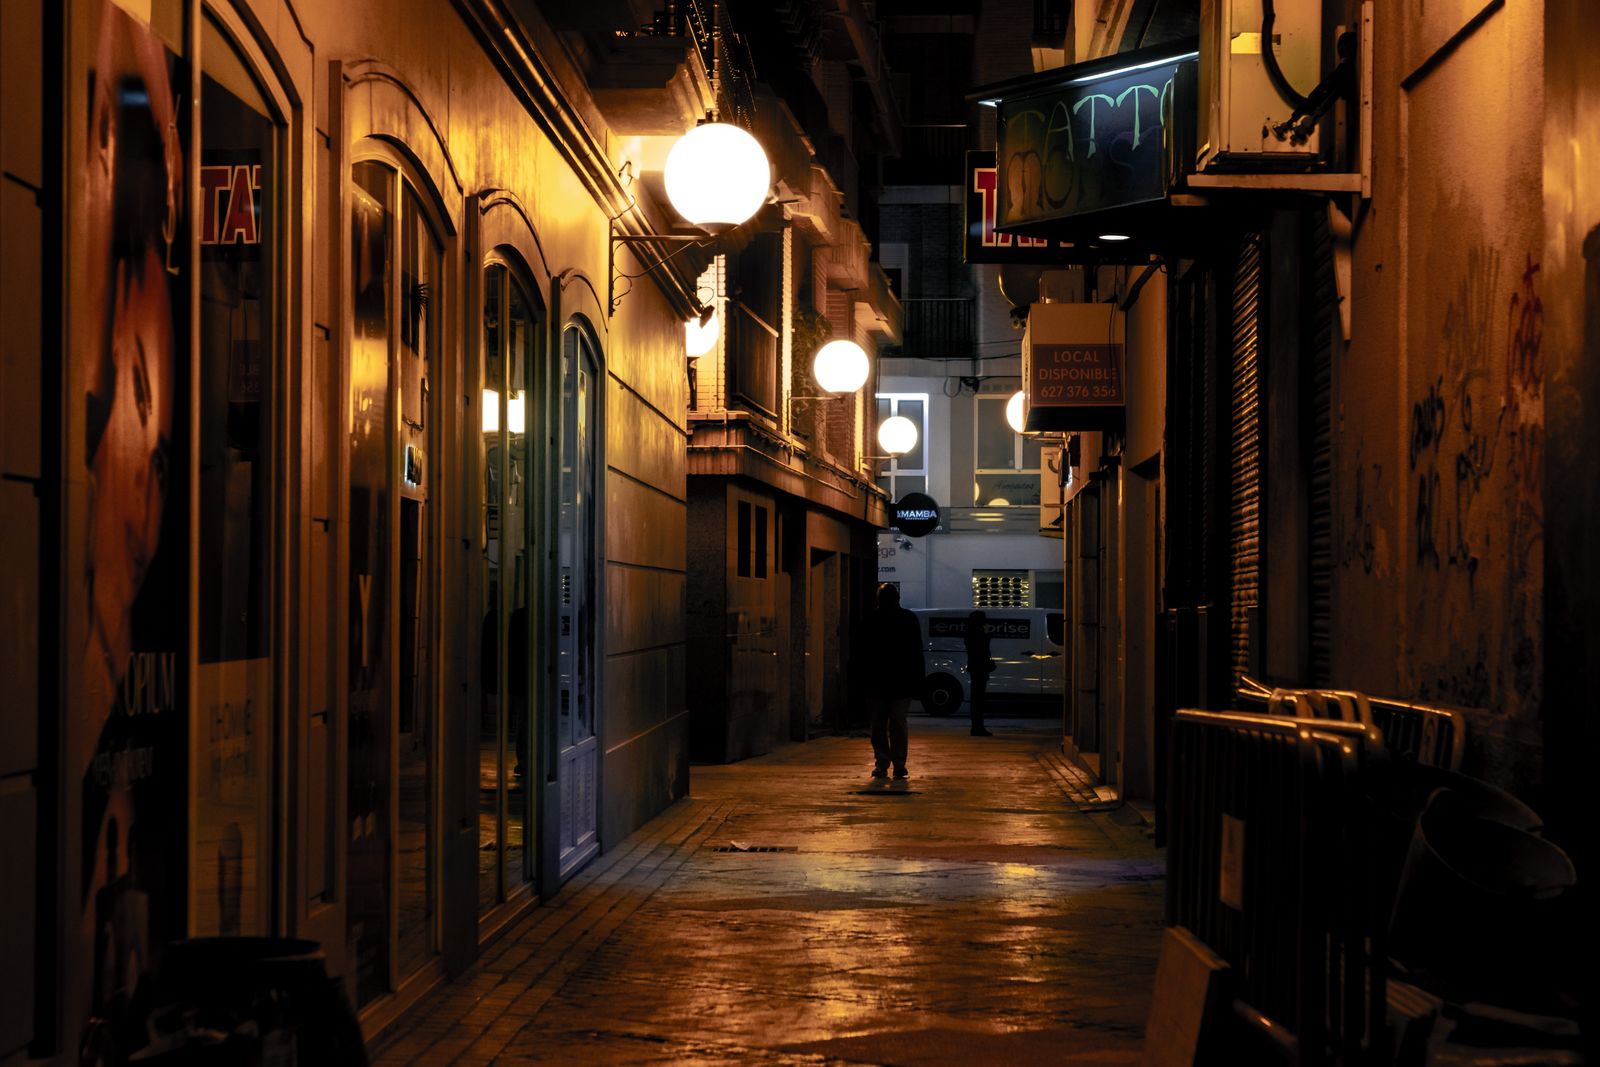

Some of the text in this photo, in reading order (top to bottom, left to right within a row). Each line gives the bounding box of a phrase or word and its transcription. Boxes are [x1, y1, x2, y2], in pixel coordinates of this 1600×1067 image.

[1054, 350, 1100, 363] LOCAL
[1039, 367, 1118, 380] DISPONIBLE
[1040, 385, 1063, 398] 627
[1066, 385, 1089, 398] 376
